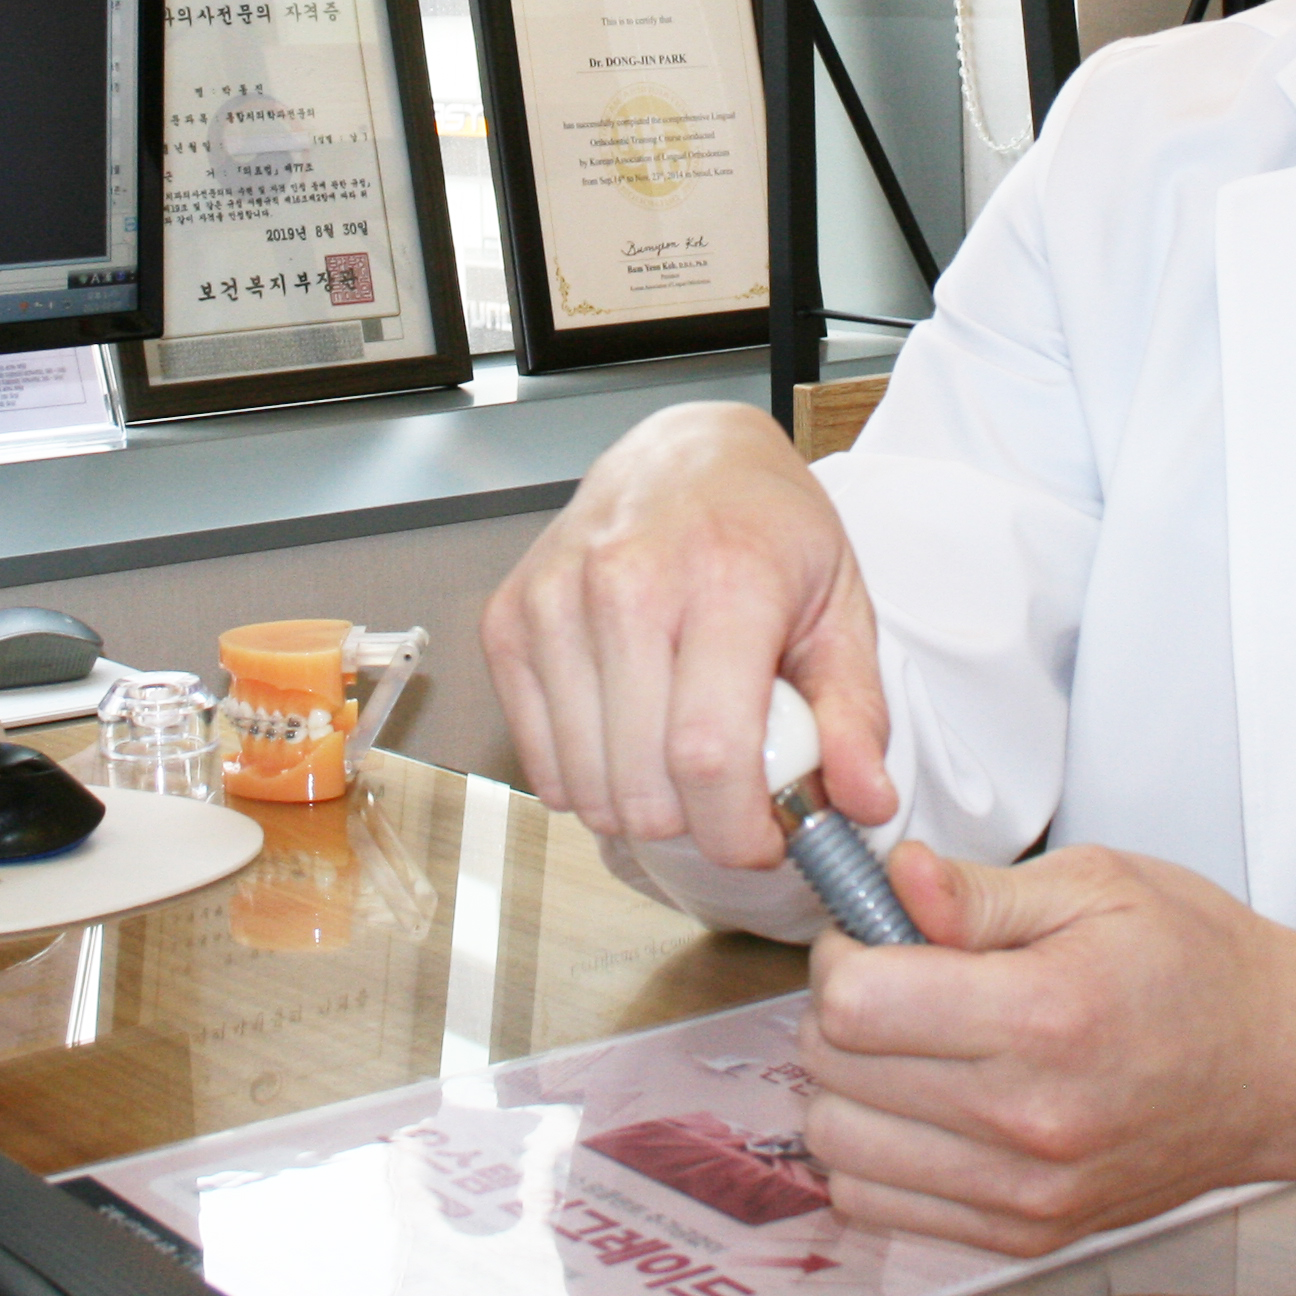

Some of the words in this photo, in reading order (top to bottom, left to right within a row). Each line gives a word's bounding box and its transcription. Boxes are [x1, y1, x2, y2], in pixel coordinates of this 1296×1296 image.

[284, 0, 341, 24] 자격증
[601, 16, 617, 27] This
[635, 15, 659, 28] certify
[659, 14, 673, 25] that
[588, 57, 604, 69] Dr.
[605, 54, 657, 68] DONG-JIN
[659, 53, 688, 66] PARK
[563, 120, 575, 130] has
[711, 110, 736, 122] Lingual
[579, 157, 588, 169] by
[582, 176, 598, 187] from
[266, 225, 308, 242] 2019년
[315, 222, 335, 240] 8월
[343, 220, 370, 237] 30일
